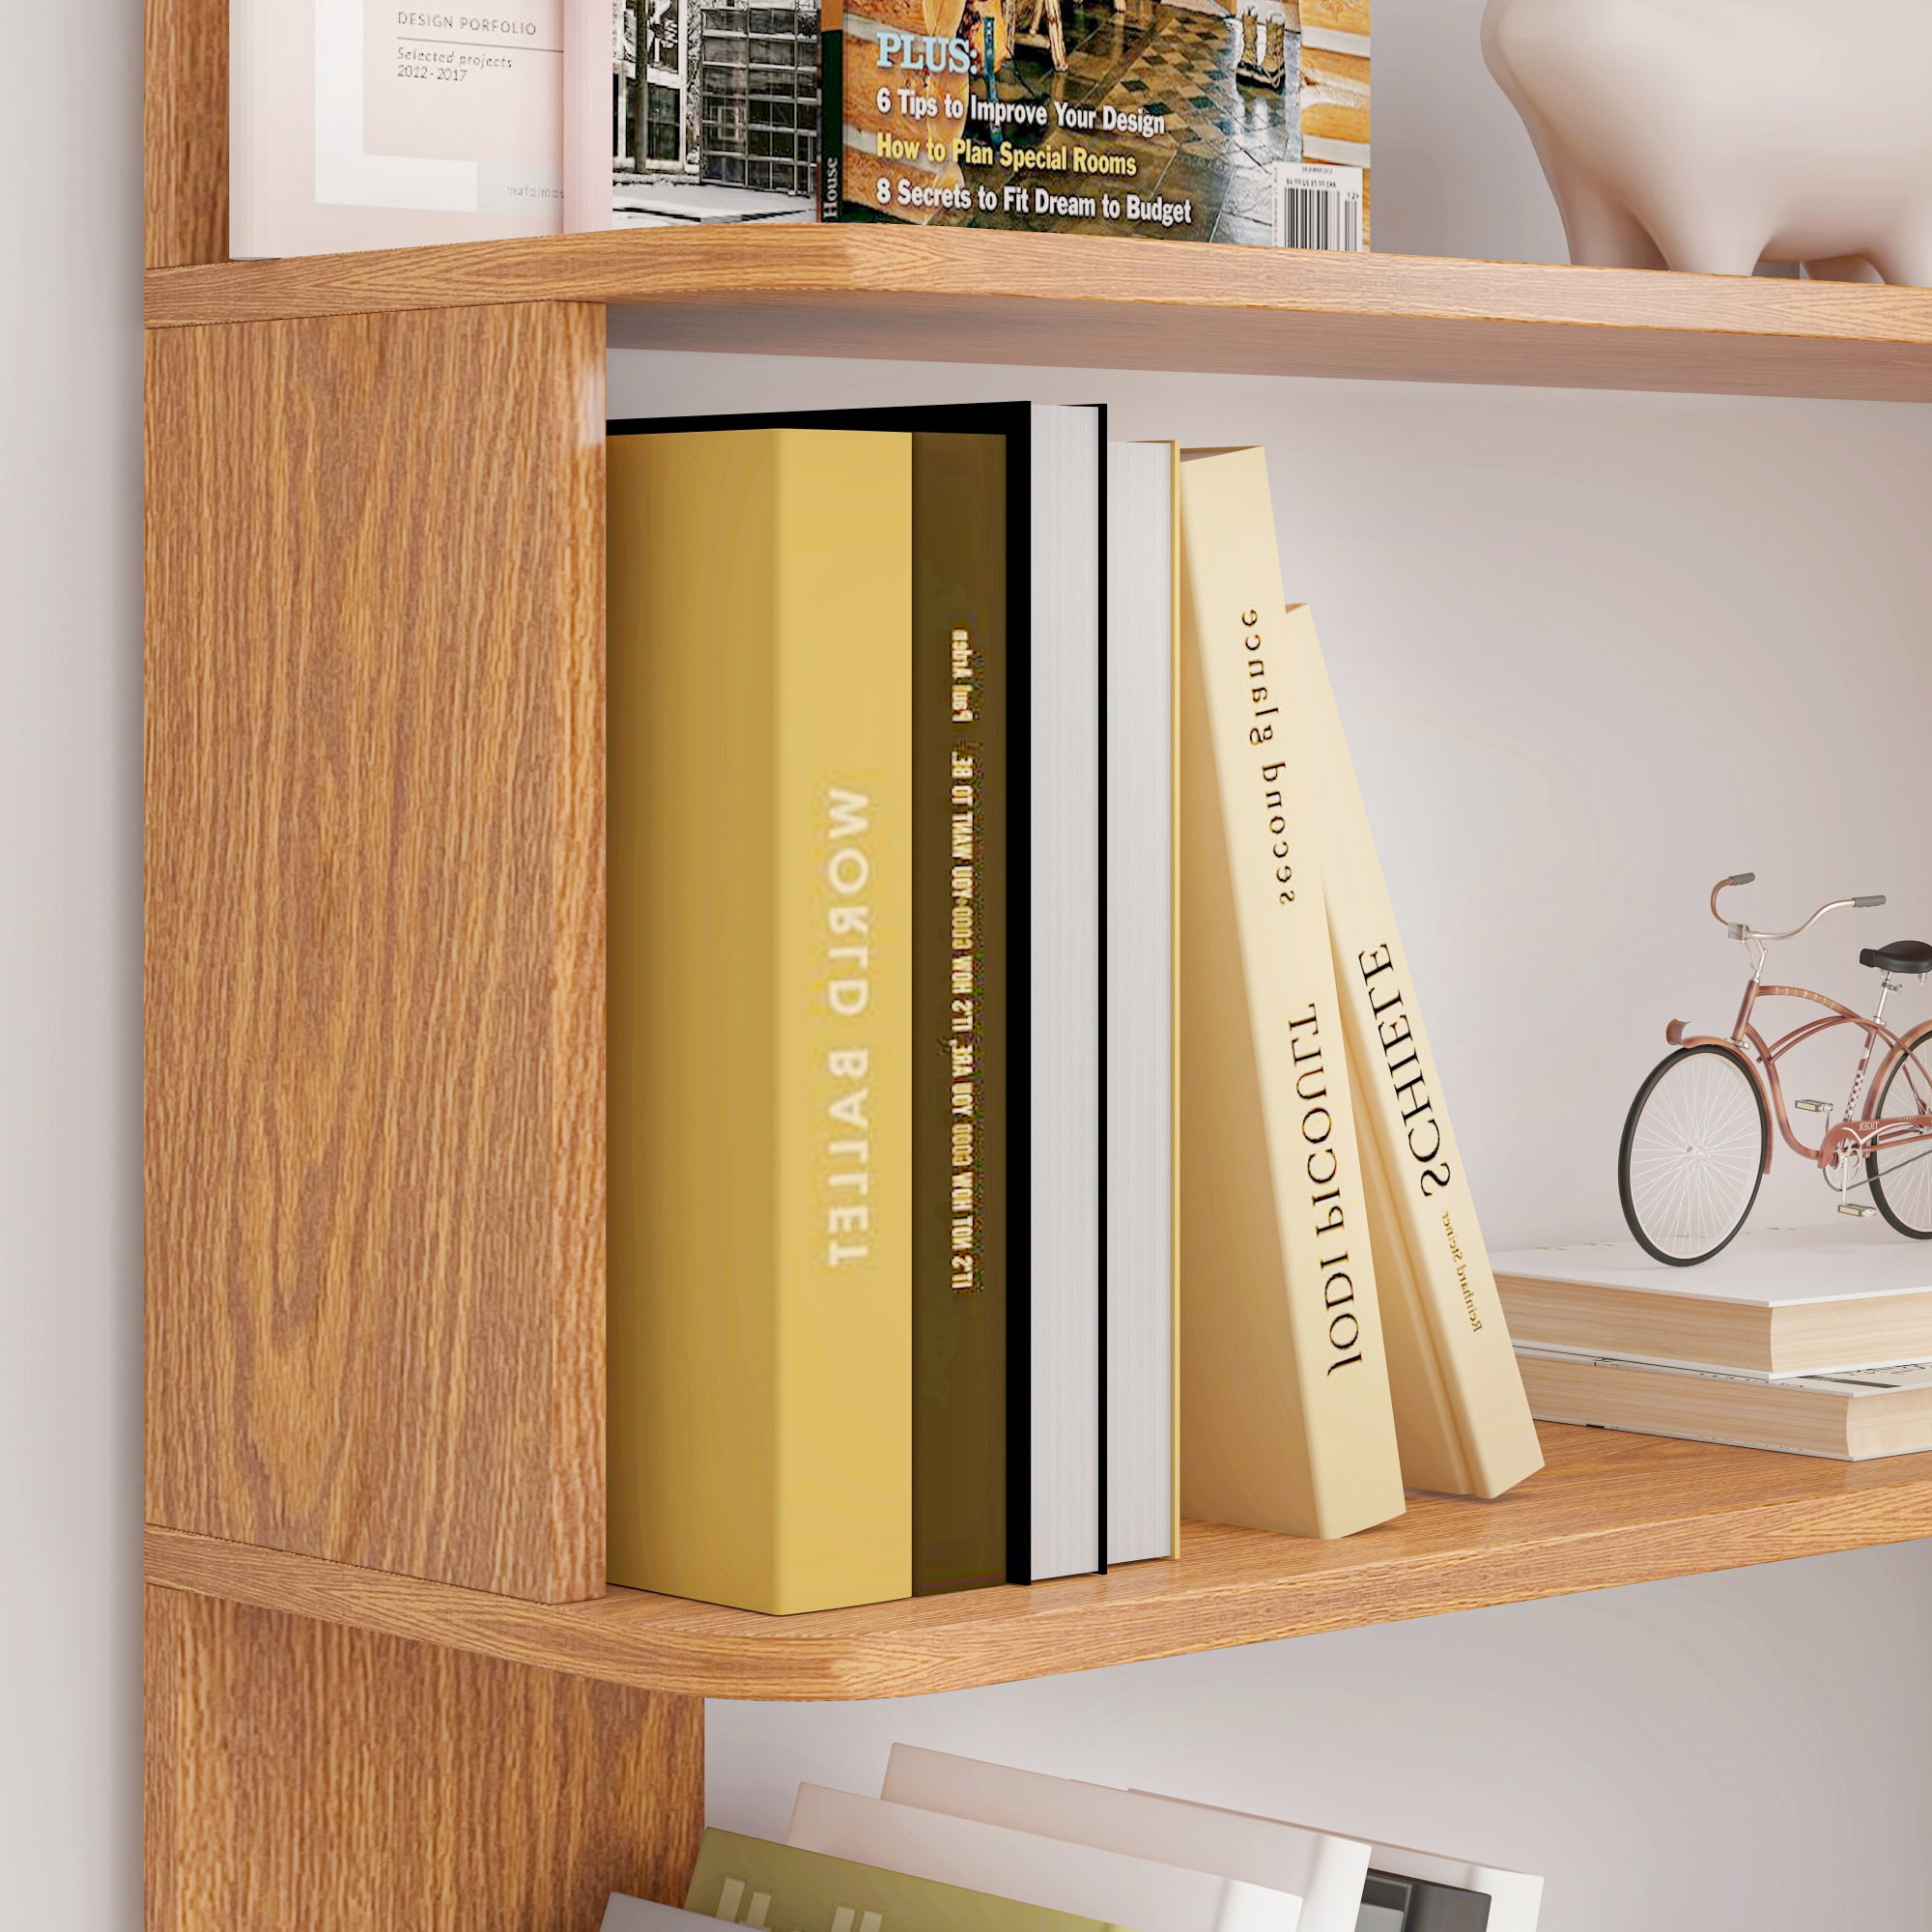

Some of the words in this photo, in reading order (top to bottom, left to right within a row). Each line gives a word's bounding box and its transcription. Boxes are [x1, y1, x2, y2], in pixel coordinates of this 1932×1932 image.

[397, 11, 453, 28] DESIGN
[460, 16, 536, 36] PORFOLIO
[397, 46, 454, 64] Selected
[460, 54, 512, 71] projects
[876, 31, 978, 75] PLUS:
[876, 87, 892, 113] 6
[897, 89, 938, 120] Tips
[944, 93, 964, 119] to
[971, 95, 1048, 126] Improve
[1054, 101, 1097, 128] Your
[1103, 105, 1165, 138] Design
[876, 131, 920, 159] How
[925, 136, 946, 162] to
[952, 138, 993, 165] Plan
[1000, 141, 1066, 172] Special
[1073, 147, 1137, 176] Rooms
[823, 156, 838, 219] House
[876, 177, 892, 204] 8
[897, 178, 972, 209] Secrets
[978, 185, 998, 211] to
[1004, 186, 1029, 213] Fit
[1035, 187, 1096, 217] Dream
[1101, 193, 1121, 219] to
[1126, 193, 1192, 227] Budget
